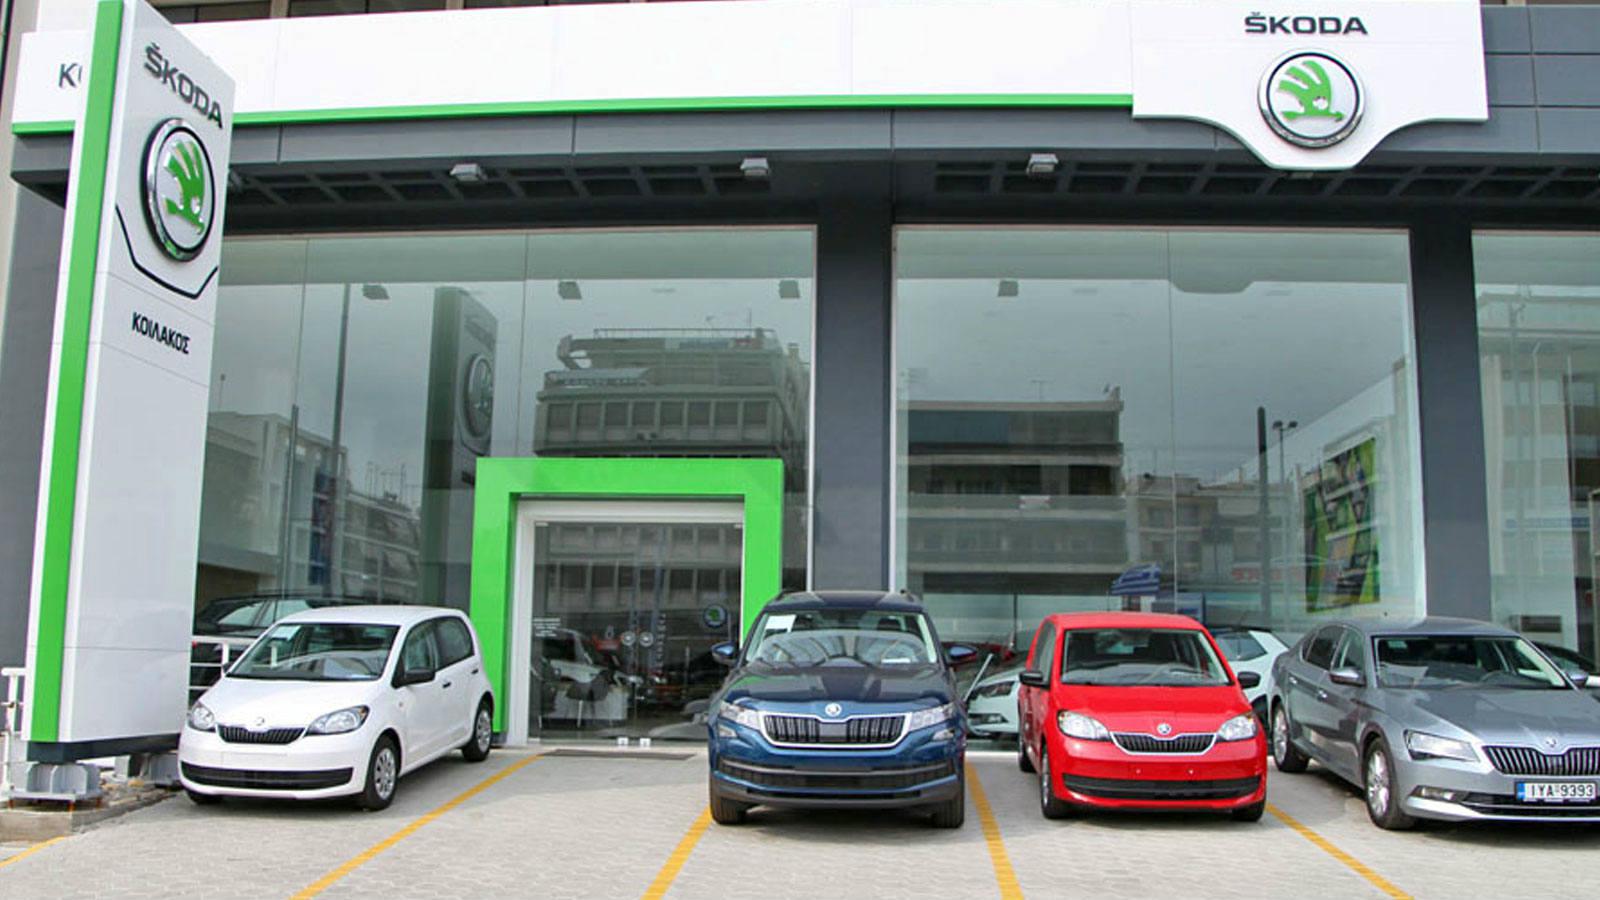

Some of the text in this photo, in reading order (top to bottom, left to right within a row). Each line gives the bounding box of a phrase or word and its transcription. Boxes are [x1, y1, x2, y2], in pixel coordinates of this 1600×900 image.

[1245, 11, 1368, 34] ŠKODA
[144, 42, 223, 129] ŠKODA
[132, 312, 190, 355] ΚΟΙΛΑΚΟΣ
